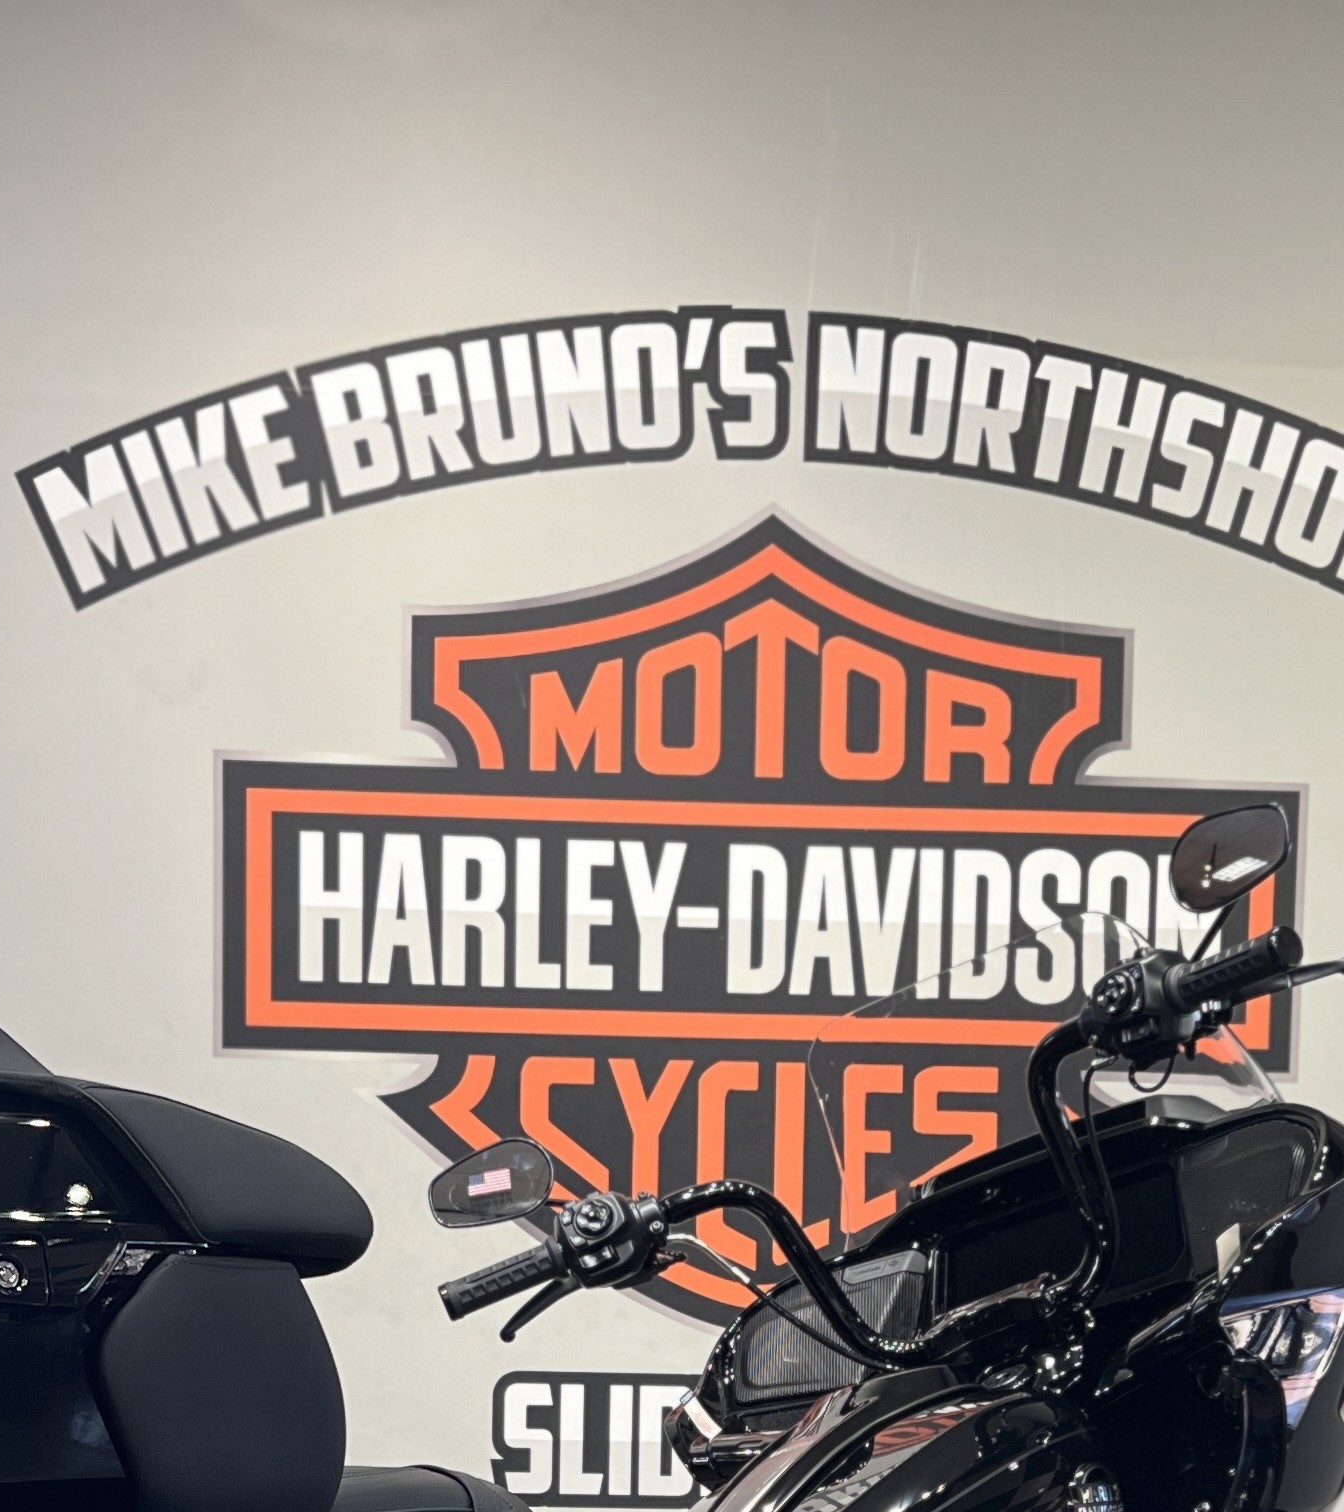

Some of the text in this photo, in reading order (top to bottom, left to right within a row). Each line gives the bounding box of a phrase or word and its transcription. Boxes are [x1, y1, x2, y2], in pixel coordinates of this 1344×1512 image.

[32, 384, 312, 595] MIKE
[310, 318, 780, 497] BRUNO'S
[529, 598, 1013, 785] MOTOR
[519, 1056, 999, 1270] CYCLES
[503, 1382, 711, 1497] SLID
